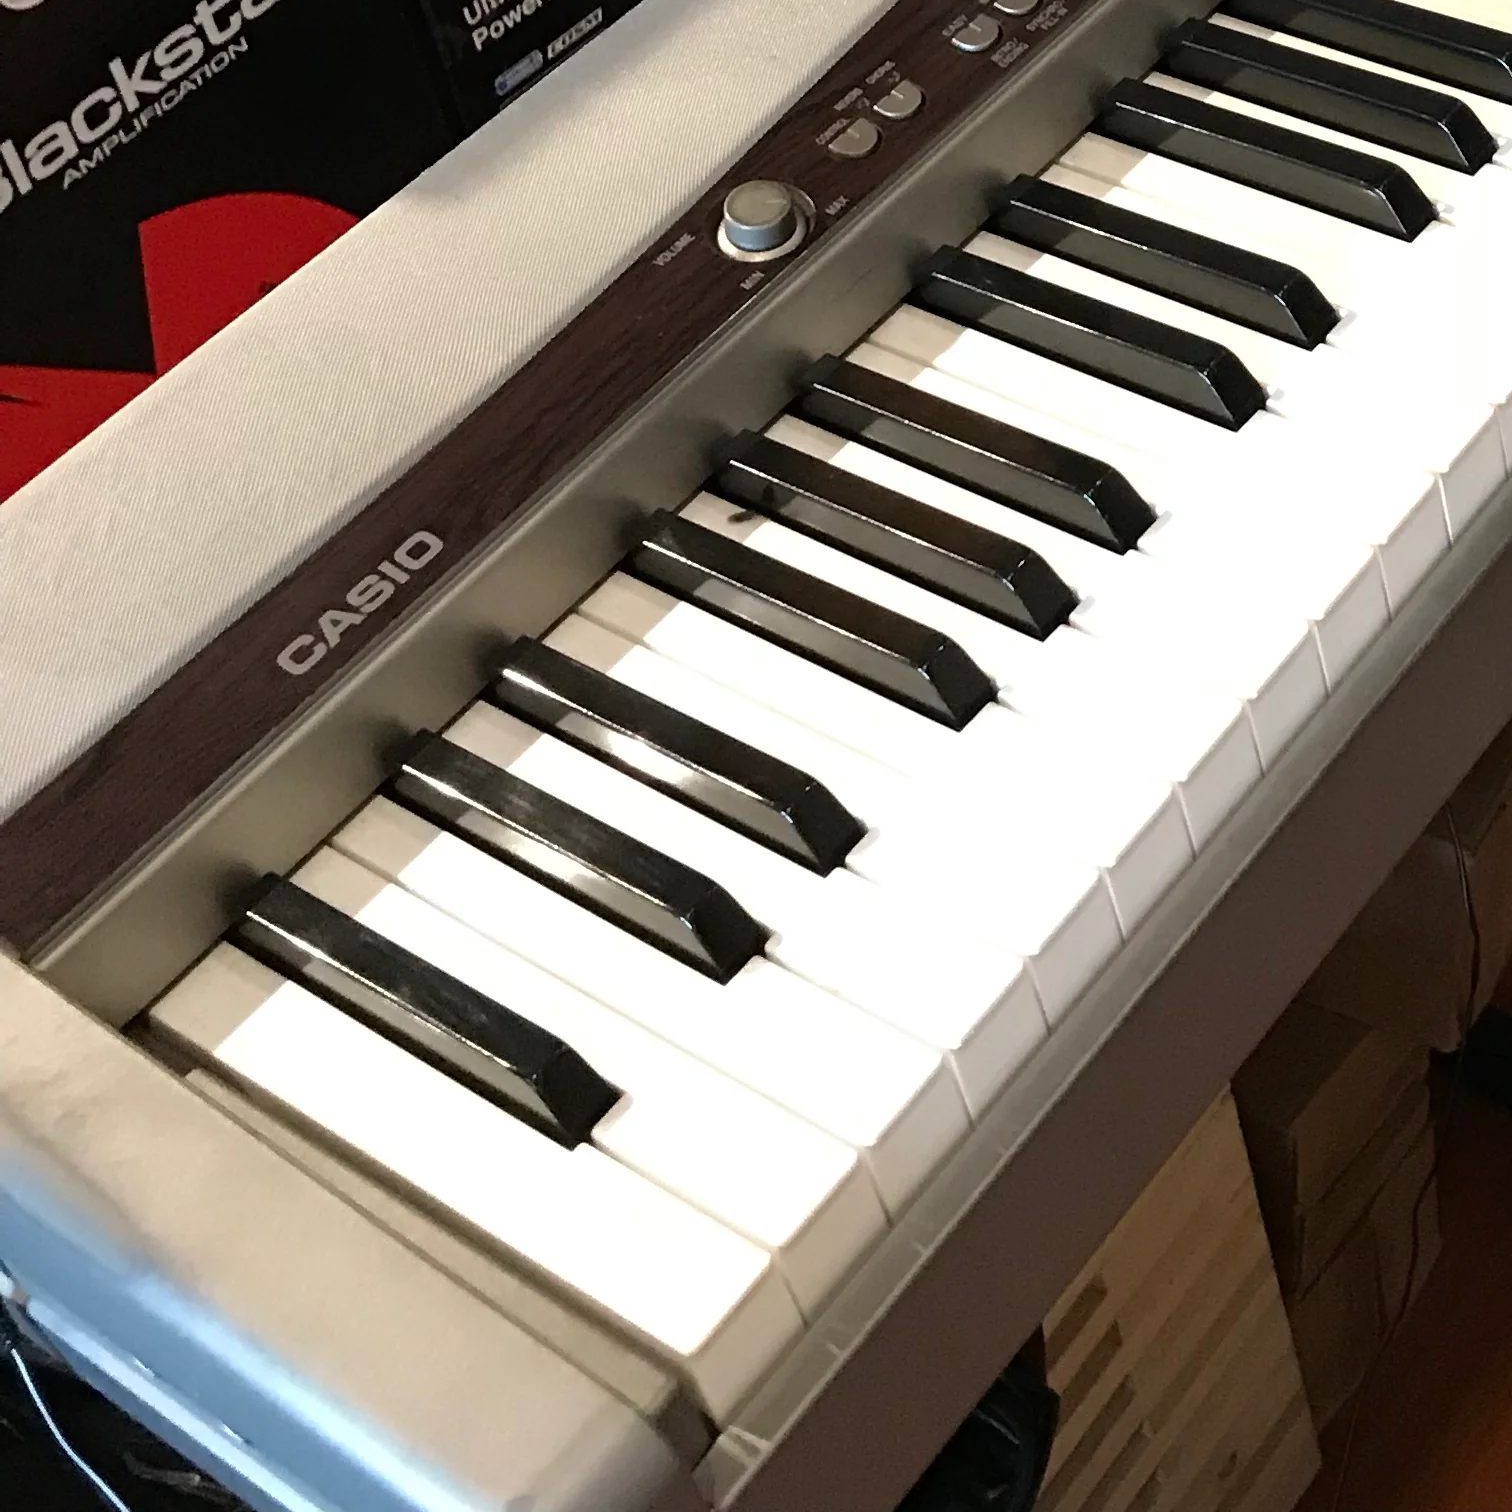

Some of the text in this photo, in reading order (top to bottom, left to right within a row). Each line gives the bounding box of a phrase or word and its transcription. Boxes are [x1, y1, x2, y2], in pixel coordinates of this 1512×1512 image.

[63, 35, 249, 191] AMPLIFICATION
[825, 195, 851, 216] MAX
[653, 232, 696, 267] VOLUME
[740, 269, 764, 290] MIN
[276, 530, 444, 675] CASIO
